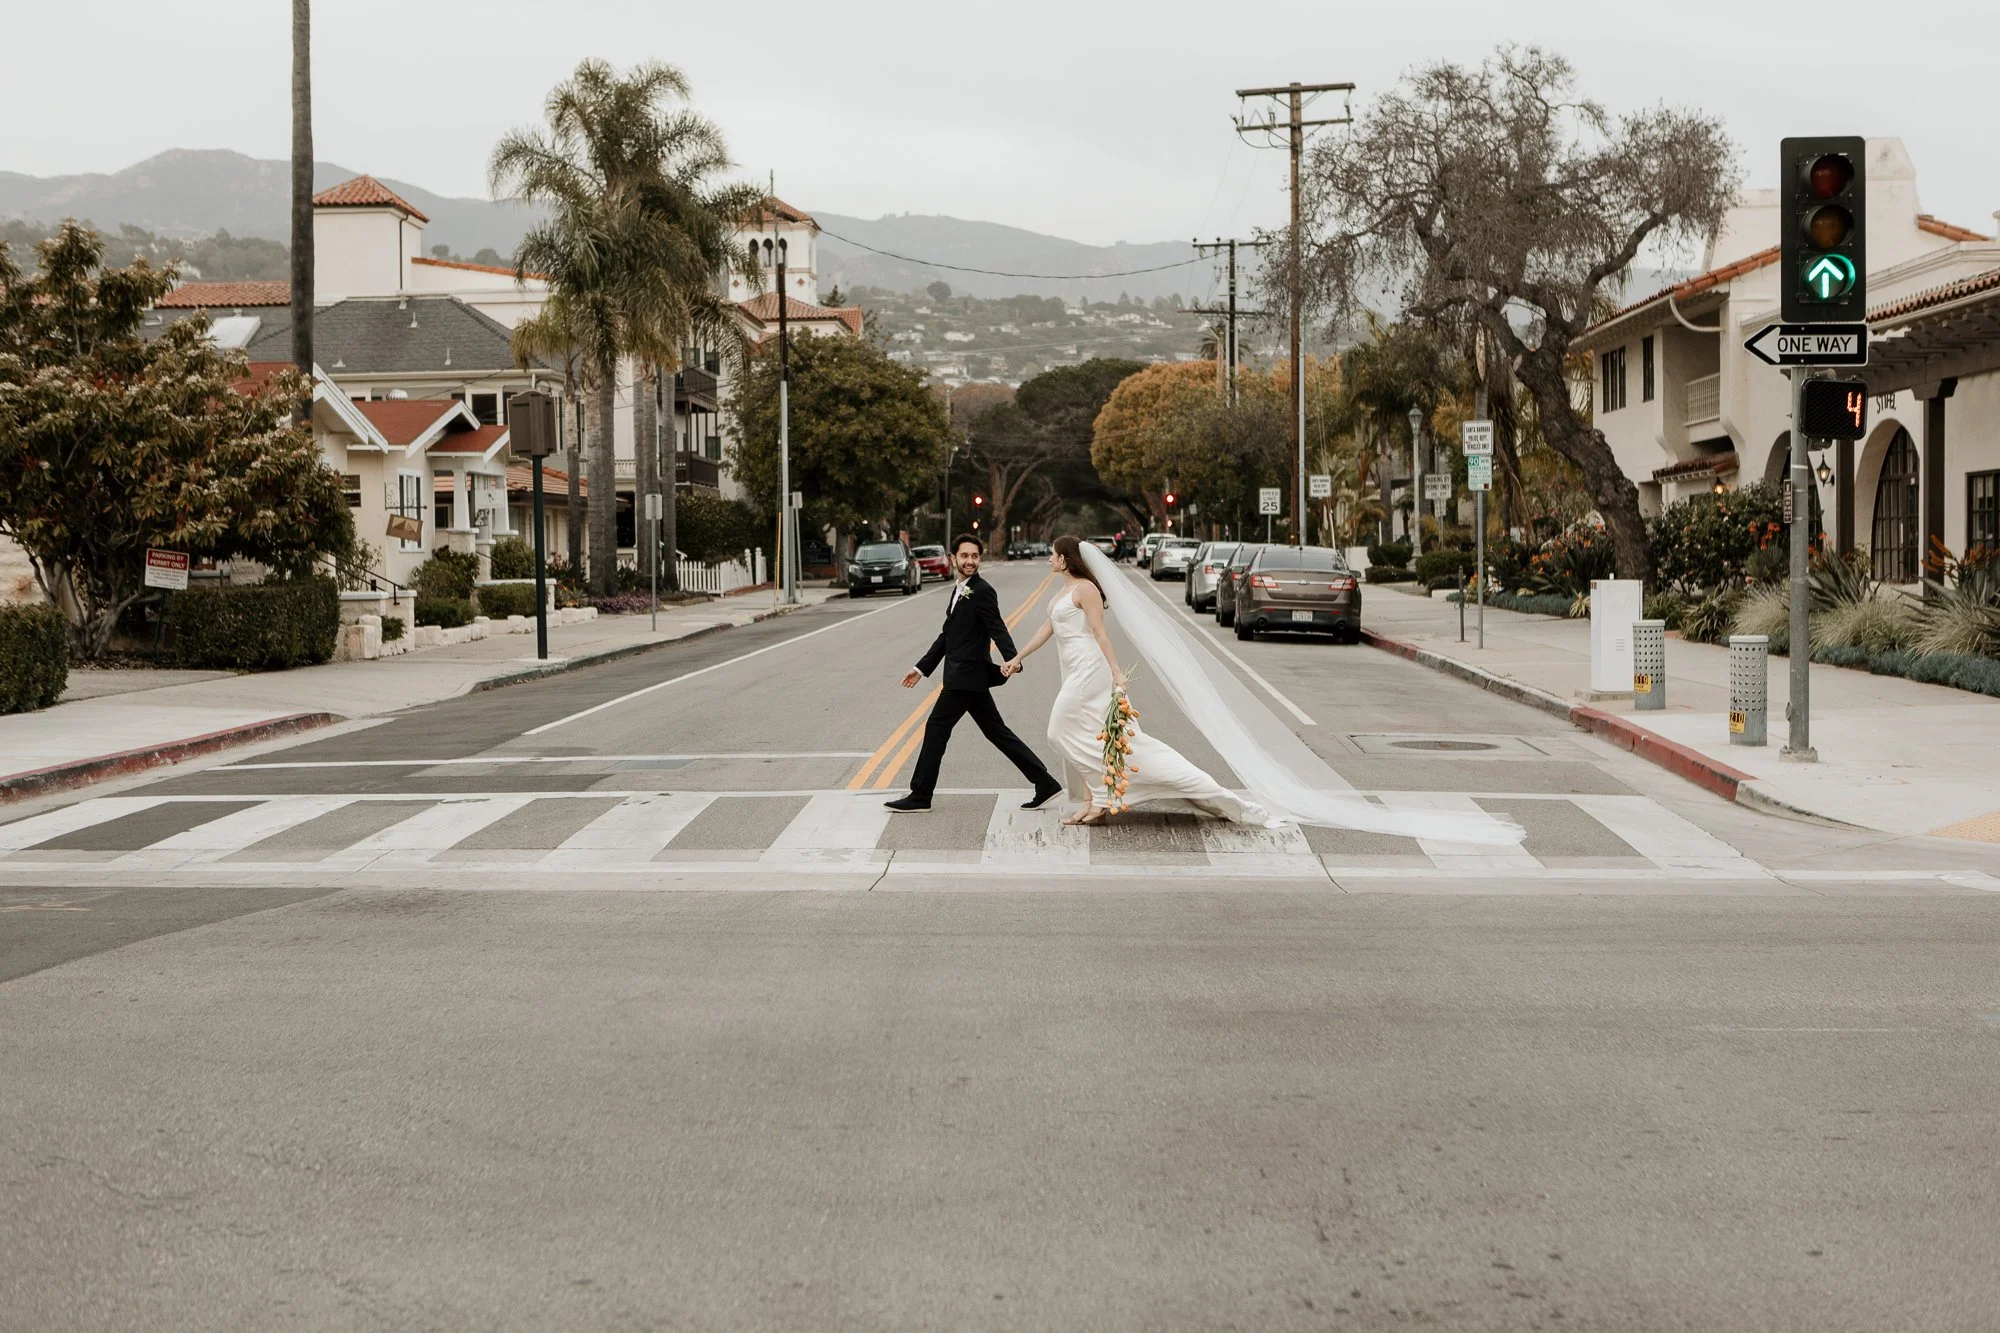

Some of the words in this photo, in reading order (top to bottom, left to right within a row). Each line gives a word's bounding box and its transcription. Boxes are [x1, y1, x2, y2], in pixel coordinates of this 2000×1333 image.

[1777, 337, 1812, 353] ONE
[1816, 337, 1852, 353] WAY
[1846, 391, 1863, 428] 4
[1469, 457, 1479, 466] 90
[1262, 502, 1278, 511] 25
[151, 552, 176, 560] PARKING
[150, 558, 170, 566] PERMIT
